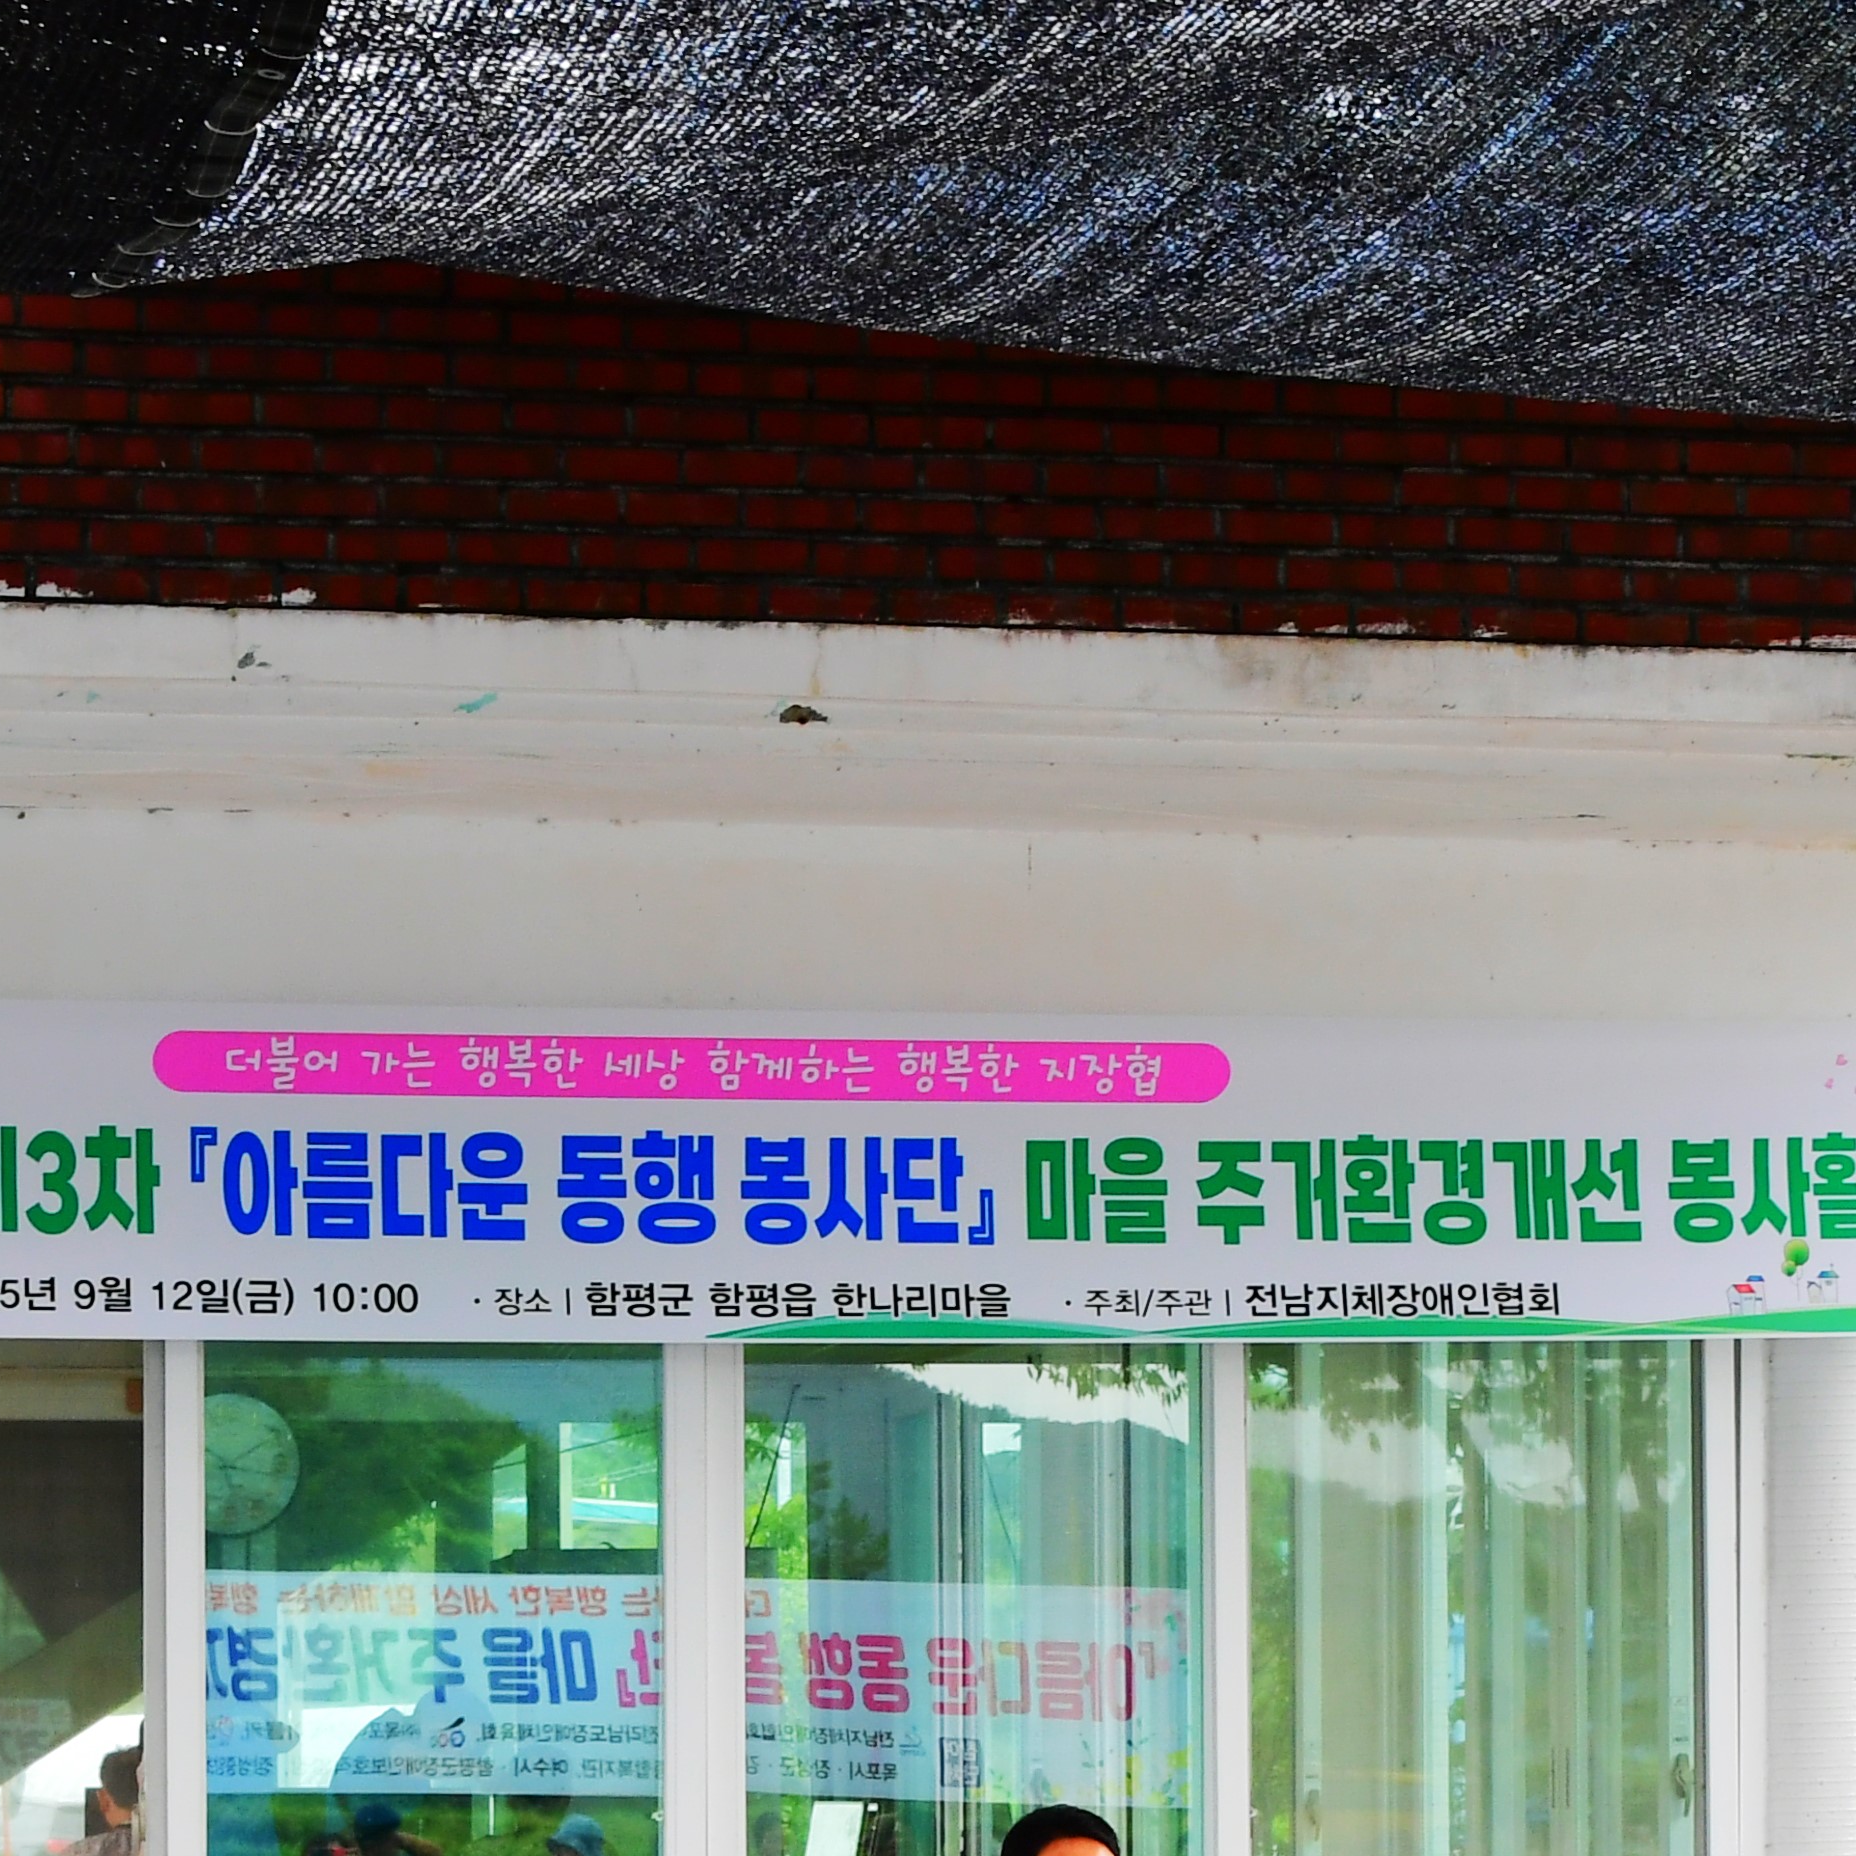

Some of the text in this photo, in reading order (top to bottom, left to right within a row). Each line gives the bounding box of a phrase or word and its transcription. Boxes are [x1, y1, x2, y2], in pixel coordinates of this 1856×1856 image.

[226, 1035, 1164, 1097] 더불어 가는 행복한 세상 함께하는 행복한 지장협
[190, 1126, 528, 1241] 『아름다운
[557, 1130, 717, 1245] 동행
[740, 1135, 995, 1246] 봉사단』
[1025, 1137, 1169, 1244] 마을
[1196, 1133, 1643, 1246] 주거환경개선
[73, 1276, 132, 1313] 9월
[151, 1277, 295, 1316] 12일(금)
[313, 1282, 419, 1314] 10:00
[494, 1287, 552, 1316] 장소
[584, 1281, 694, 1318] 함평군
[708, 1282, 817, 1318] 함평읍
[831, 1282, 1011, 1318] 한나리마을
[1084, 1287, 1212, 1318] 주최/주관
[1245, 1281, 1561, 1318] 전남지체장애인협회
